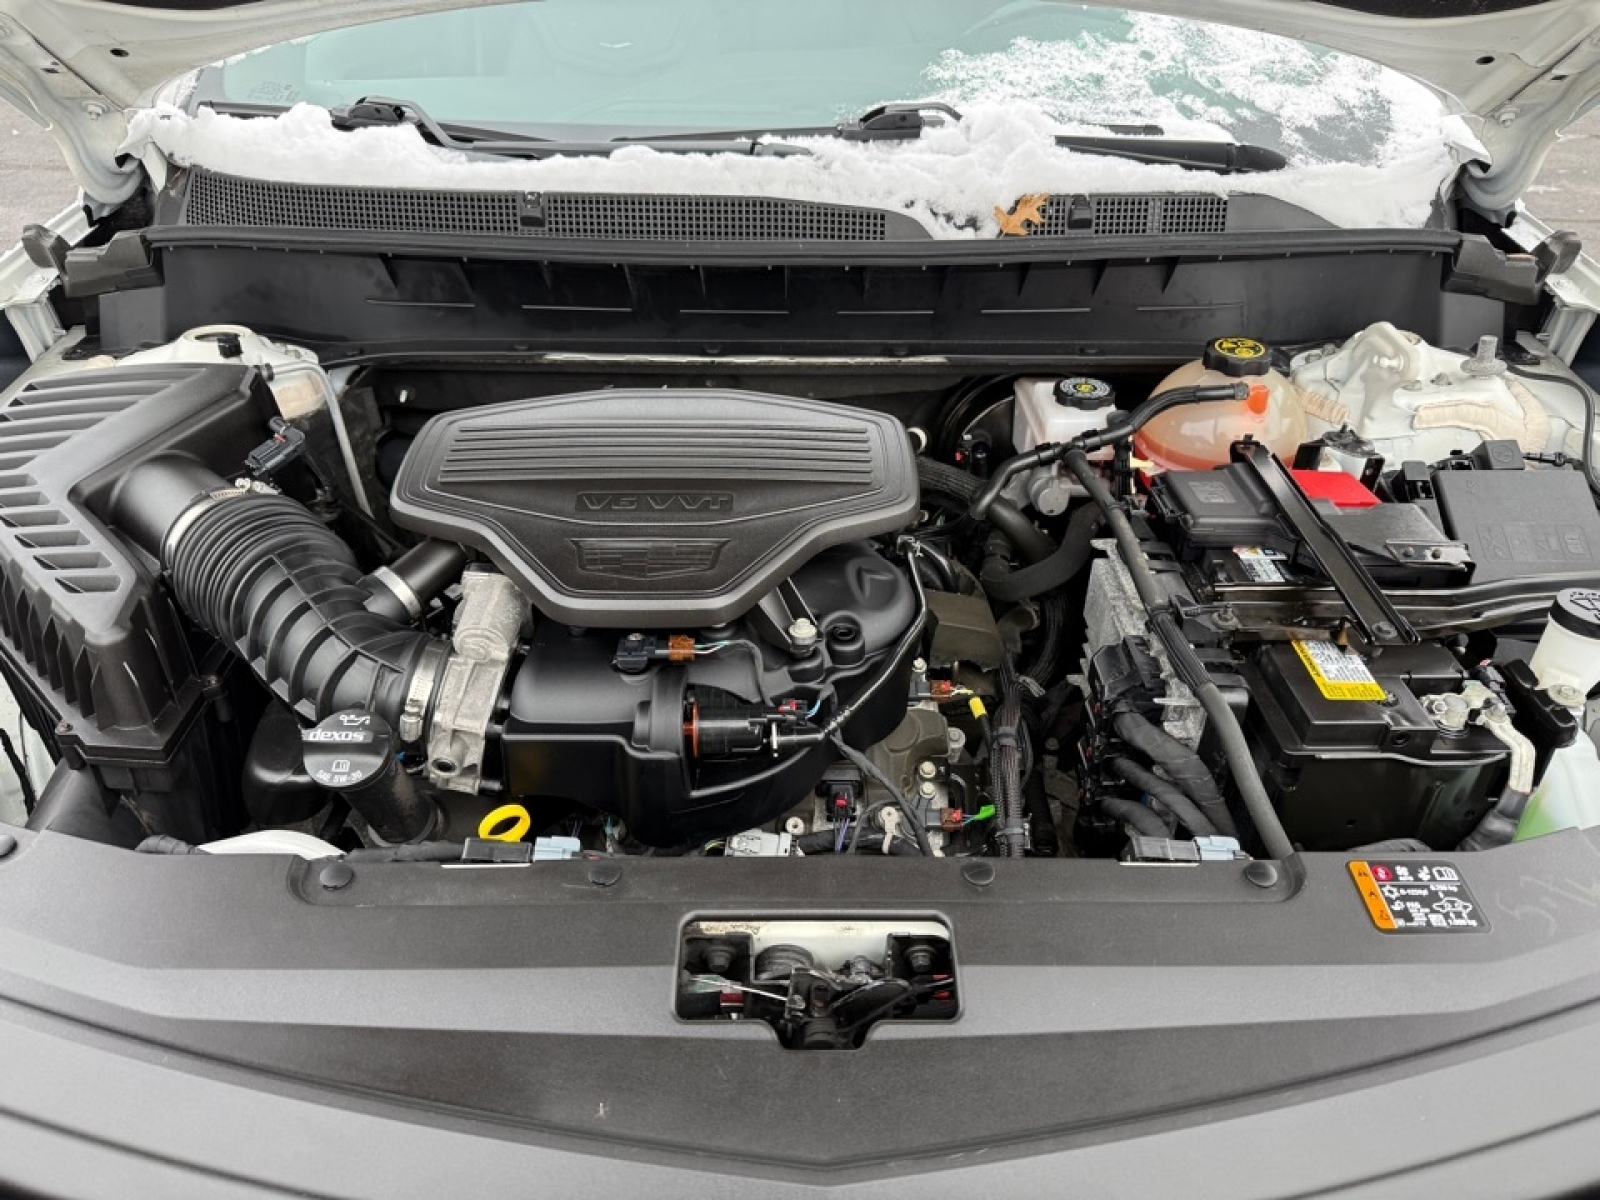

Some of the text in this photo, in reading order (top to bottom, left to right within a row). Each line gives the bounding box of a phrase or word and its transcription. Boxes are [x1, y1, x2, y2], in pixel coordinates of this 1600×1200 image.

[582, 495, 729, 509] V6 VVT
[308, 728, 367, 741] dexos
